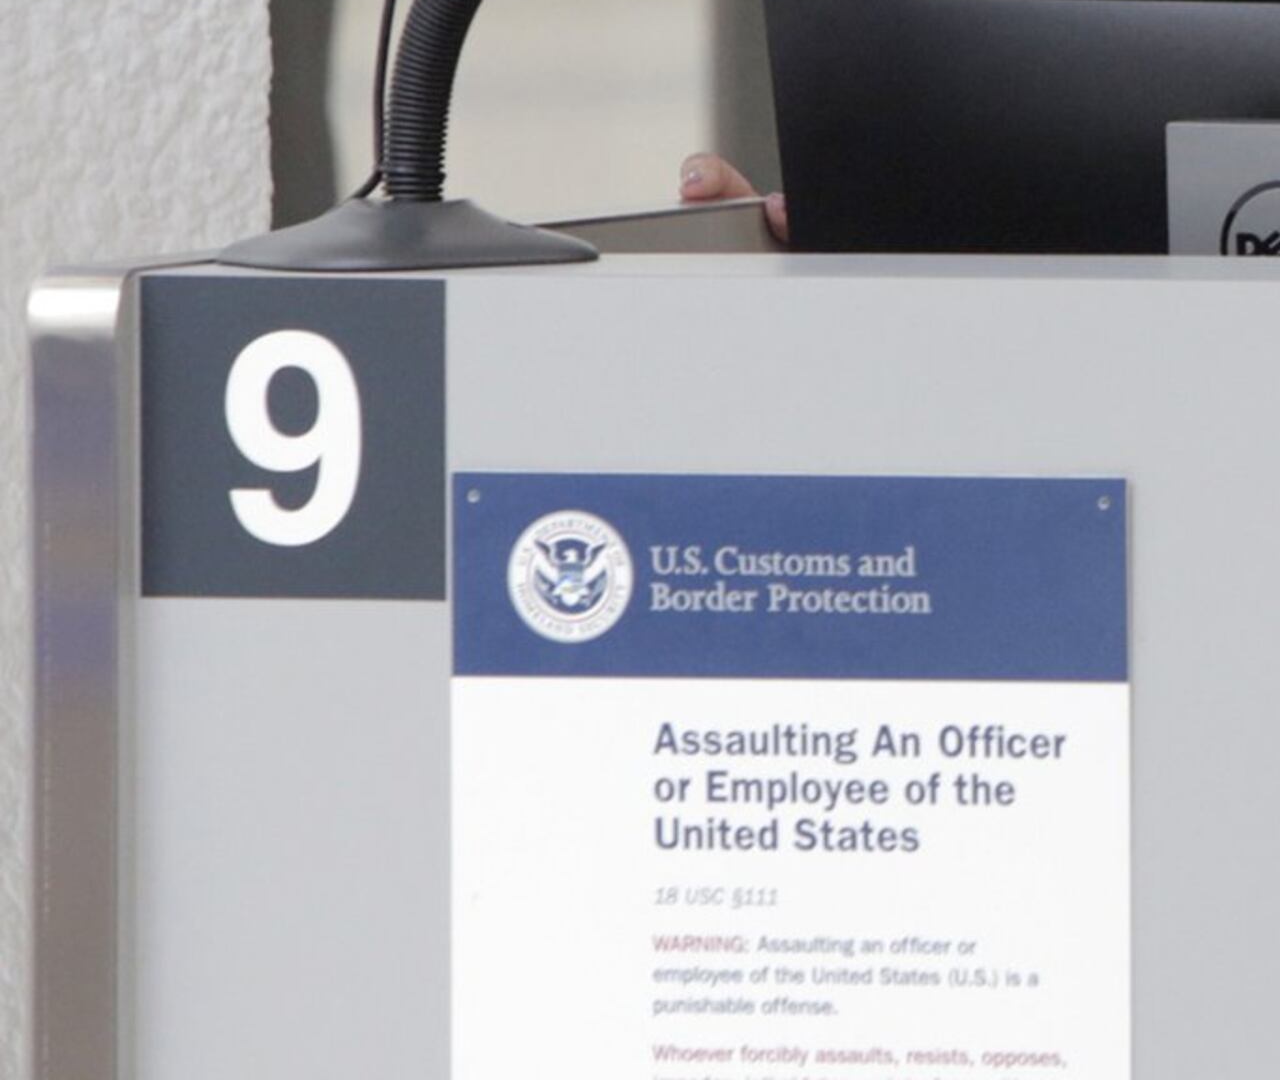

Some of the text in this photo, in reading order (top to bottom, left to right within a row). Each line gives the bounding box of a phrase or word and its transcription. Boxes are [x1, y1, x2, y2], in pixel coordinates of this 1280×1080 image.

[225, 329, 362, 547] 9
[651, 546, 708, 574] U.S.
[714, 546, 851, 575] Customs
[857, 547, 915, 576] and
[651, 583, 931, 613] Border Protection
[653, 722, 1067, 764] Assaulting An Officer
[653, 770, 1015, 812] or Employee of the
[654, 817, 920, 853] United States
[654, 886, 778, 910] 18 USC §111
[652, 934, 977, 958] WARNING: Assaulting an officer or
[652, 966, 1040, 988] employee of the United States (U.S.) is a
[652, 996, 839, 1017] punishable offense.
[651, 1043, 1068, 1070] Whoever forcibly assaults, resists, opposes,
